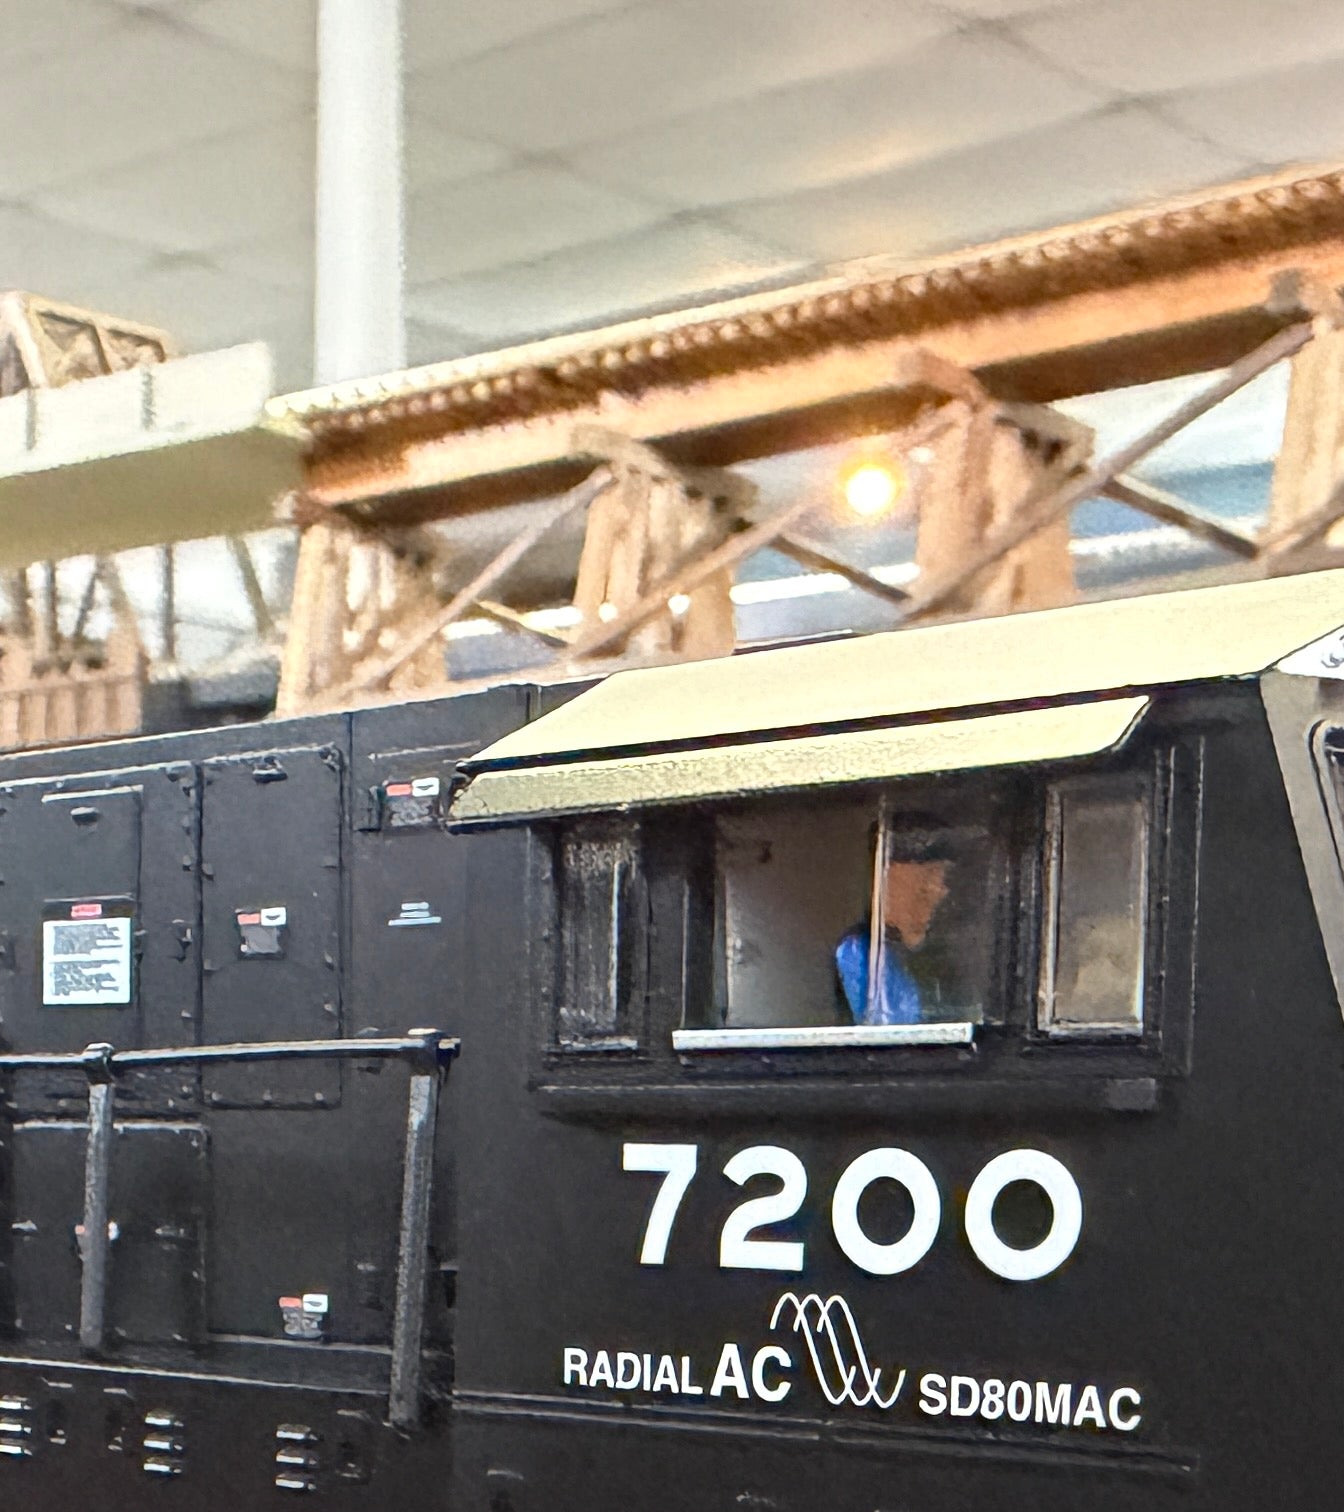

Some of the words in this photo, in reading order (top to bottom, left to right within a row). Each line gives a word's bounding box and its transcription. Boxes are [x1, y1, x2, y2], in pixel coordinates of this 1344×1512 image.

[622, 1143, 1083, 1281] 7200
[563, 1346, 703, 1394] RADIAL
[711, 1342, 793, 1402] AC
[918, 1372, 1142, 1431] SD80MAC
